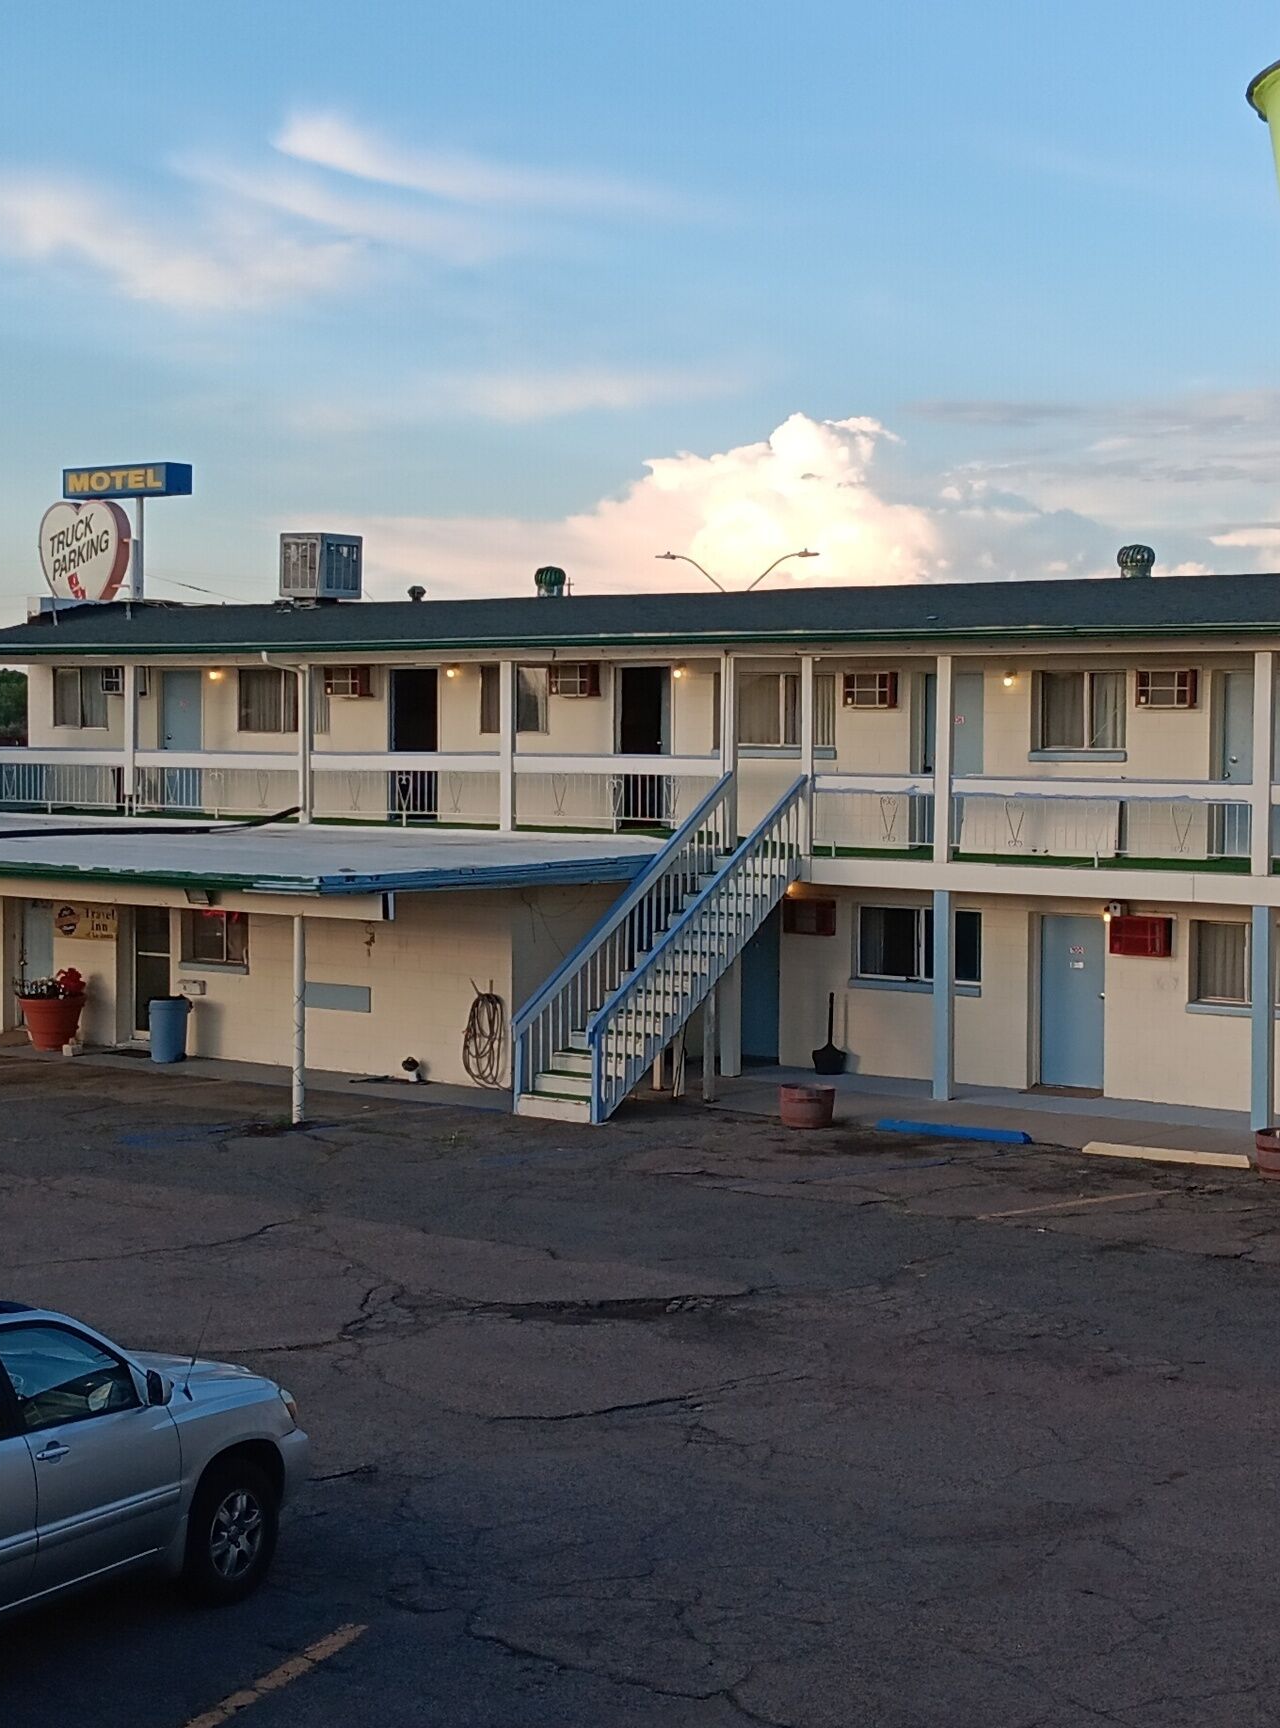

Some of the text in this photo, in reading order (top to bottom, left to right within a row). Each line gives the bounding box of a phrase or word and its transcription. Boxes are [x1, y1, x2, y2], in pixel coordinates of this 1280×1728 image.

[69, 469, 162, 492] MOTEL
[49, 513, 94, 557] TRUCK
[52, 530, 110, 581] PARKING
[84, 908, 115, 920] Travel
[91, 920, 108, 931] Inn
